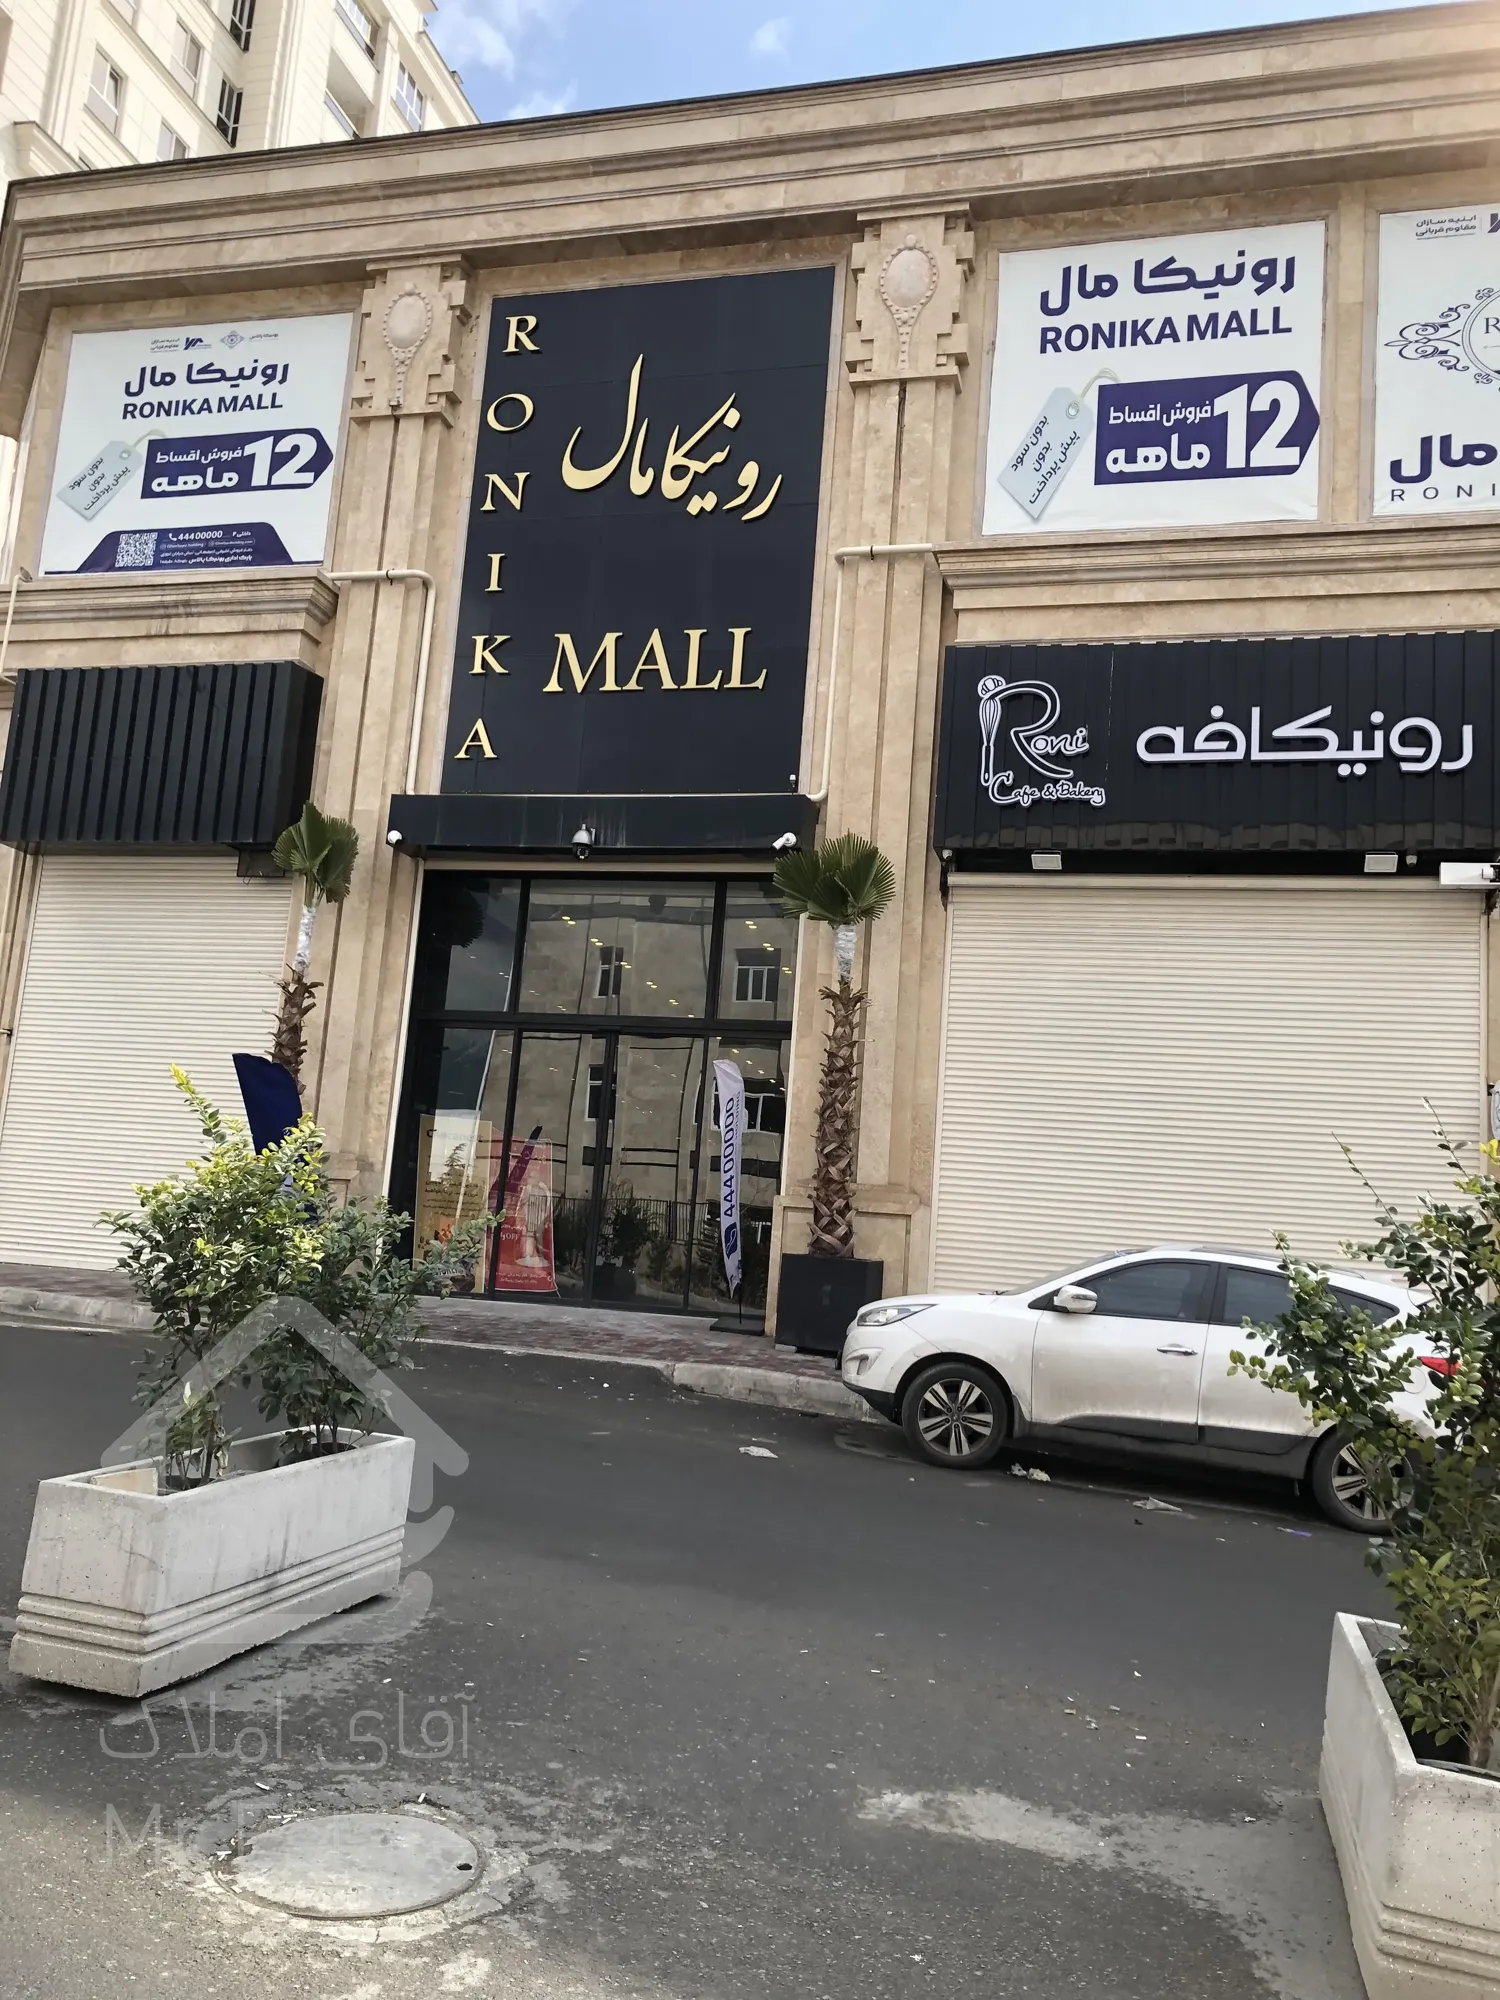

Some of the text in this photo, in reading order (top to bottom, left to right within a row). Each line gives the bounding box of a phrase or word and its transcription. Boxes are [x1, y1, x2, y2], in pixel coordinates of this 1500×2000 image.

[1039, 249, 1296, 317] رونیکا مال
[1039, 305, 1293, 354] RONIKA MALL
[124, 358, 289, 398] رونیکا مال
[122, 392, 284, 420] RONIKA MALL
[1108, 399, 1212, 427] فروش اقساط
[1213, 379, 1300, 469] 12
[155, 446, 243, 464] فروش اقساط
[243, 433, 318, 487] 12
[561, 353, 783, 521] رونیکا مال
[1011, 415, 1050, 472] بدون سود
[1033, 441, 1053, 473] بدون
[1105, 432, 1211, 475] ماهه
[1389, 433, 1498, 485] مال
[151, 466, 239, 493] ماهه
[1028, 430, 1081, 505] پیش پرداخت
[83, 483, 114, 511] پرداخت
[178, 530, 223, 541] 44400000
[543, 627, 767, 693] MALL
[979, 680, 1091, 779] Roni
[988, 769, 1106, 807] Cafe & Bakery
[723, 1097, 735, 1218] 44400000
